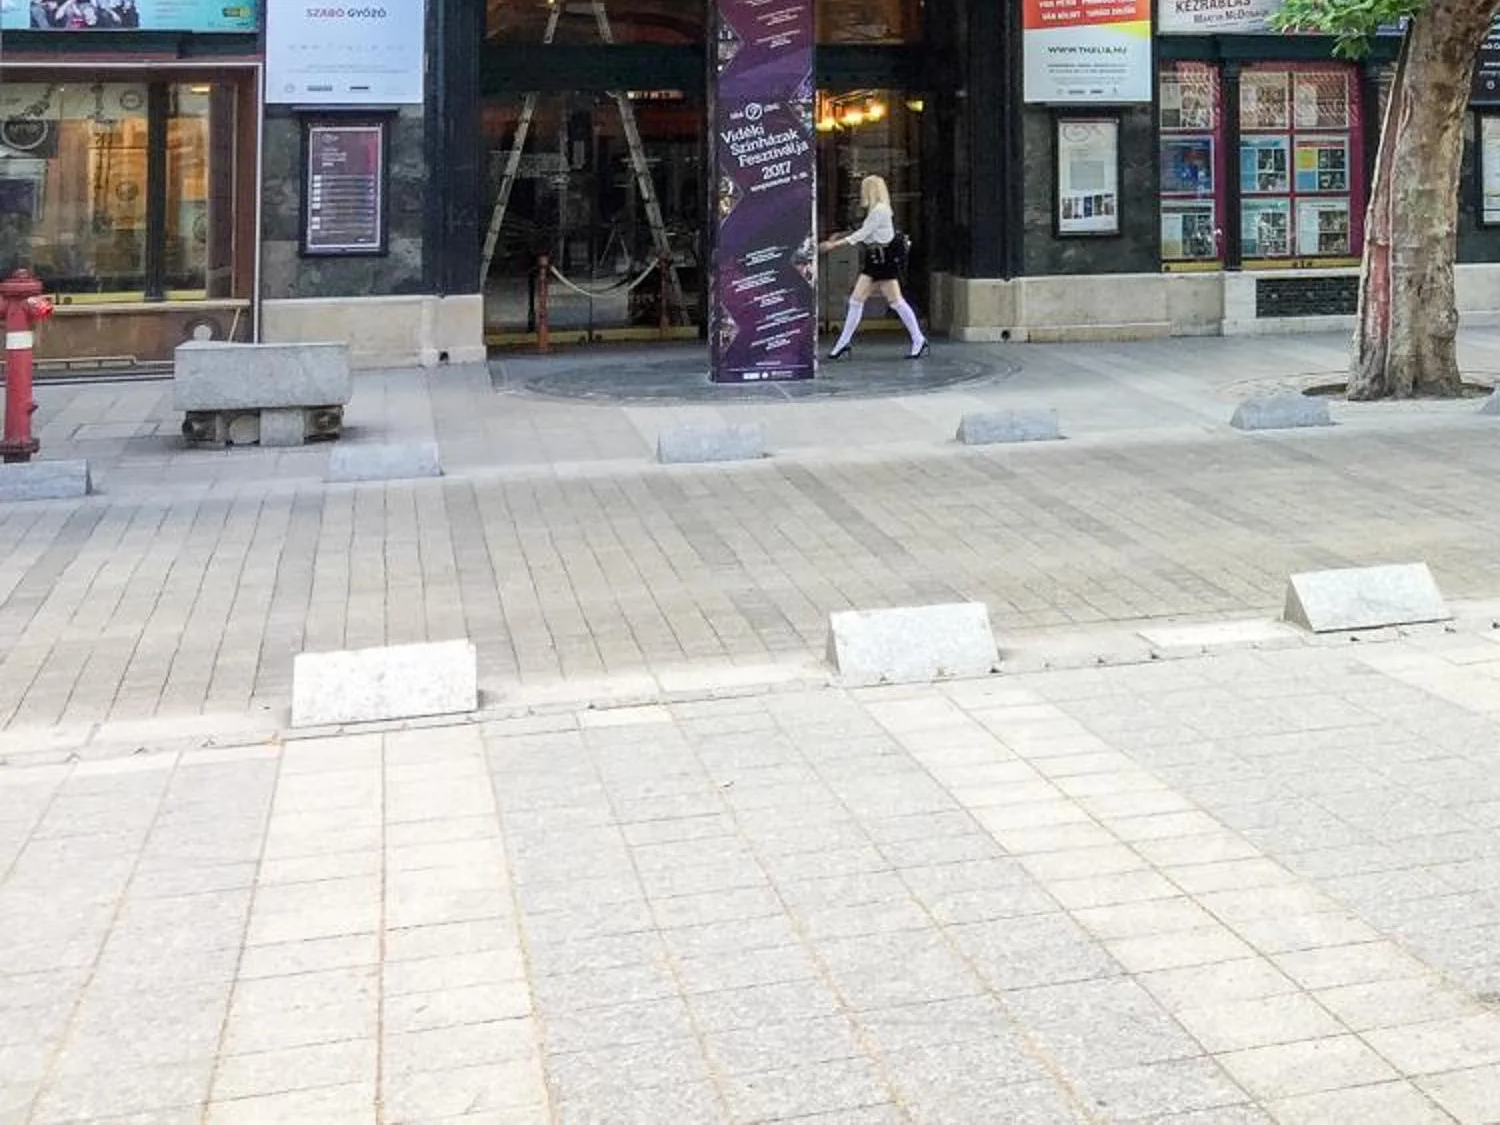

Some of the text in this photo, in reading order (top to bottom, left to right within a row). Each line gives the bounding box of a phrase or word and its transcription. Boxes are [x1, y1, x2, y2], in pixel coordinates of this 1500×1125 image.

[306, 7, 345, 18] SZABÓ
[720, 122, 765, 144] Vidéki
[761, 160, 791, 180] 2017
